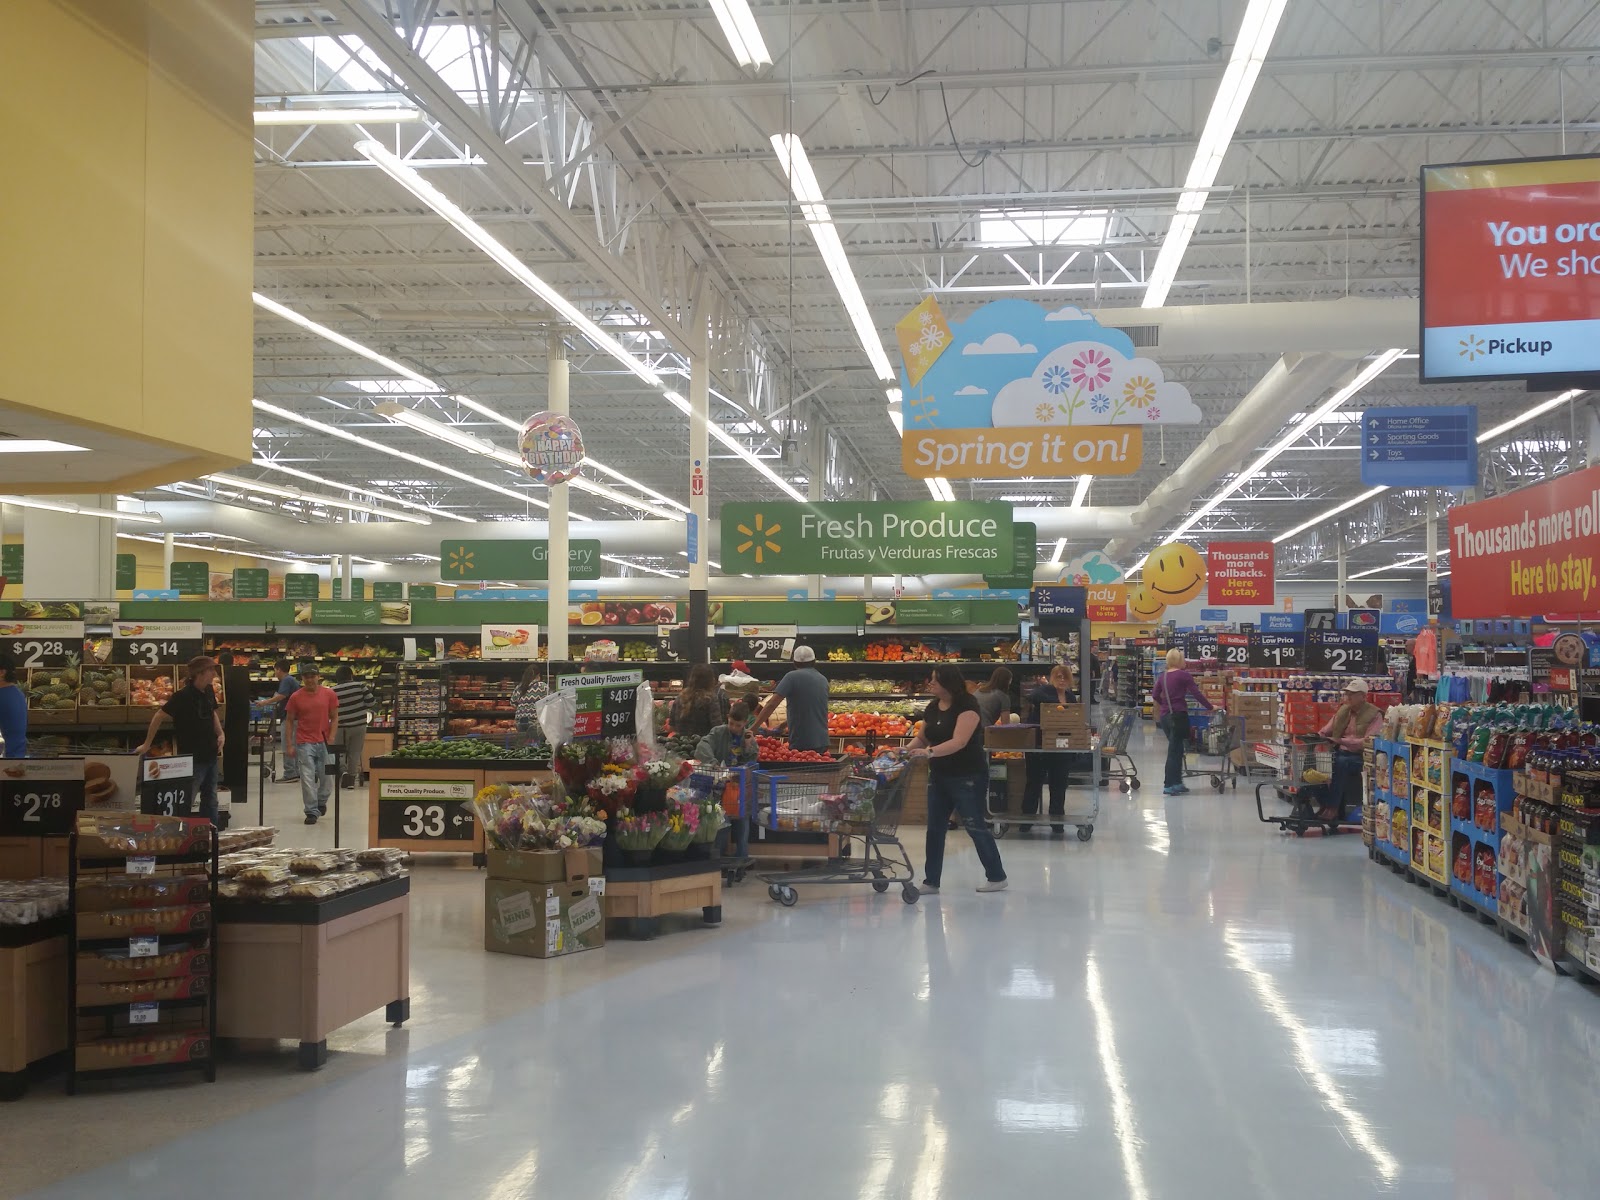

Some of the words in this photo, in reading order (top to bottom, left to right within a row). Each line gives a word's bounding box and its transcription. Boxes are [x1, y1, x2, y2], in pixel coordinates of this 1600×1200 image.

[1487, 221, 1547, 247] You
[1499, 253, 1548, 279] We
[1488, 338, 1553, 356] Pickup
[1409, 417, 1430, 425] Office
[537, 439, 572, 451] HAPPY
[1387, 433, 1416, 441] Sporting
[528, 451, 581, 465] BIRTHDAY
[914, 434, 1032, 471] Spring
[1039, 433, 1066, 462] it
[1071, 433, 1131, 460] on!
[801, 513, 876, 539] Fresh
[883, 512, 998, 539] Produce
[1454, 509, 1536, 559] Thousands
[1539, 509, 1572, 547] more
[532, 546, 593, 565] Grery
[820, 545, 866, 560] Frutas
[867, 548, 876, 562] y
[878, 545, 942, 560] Verduras
[945, 545, 998, 560] Frescas
[1212, 551, 1269, 561] Thousands
[1215, 568, 1267, 578] rollbacks.
[1510, 559, 1544, 596] Here
[1546, 557, 1558, 594] to
[1561, 553, 1597, 602] stay.
[1228, 579, 1254, 588] Here
[1087, 587, 1117, 603] ndy
[1221, 588, 1233, 597] to
[1235, 588, 1260, 598] stay.
[1323, 635, 1341, 643] Low
[1341, 635, 1363, 644] Price
[13, 641, 63, 668] $228
[129, 641, 179, 667] $314
[748, 639, 780, 659] $298
[1263, 647, 1295, 666] $150
[1324, 648, 1363, 671] $212
[561, 677, 580, 687] Fresh
[580, 675, 606, 686] Quality
[606, 674, 631, 684] Flowers
[610, 689, 635, 704] $487
[573, 716, 588, 726] yday
[605, 711, 631, 727] $987
[13, 793, 61, 822] $278
[157, 789, 185, 817] $312
[402, 804, 446, 837] 33
[1560, 819, 1575, 834] ROCKS
